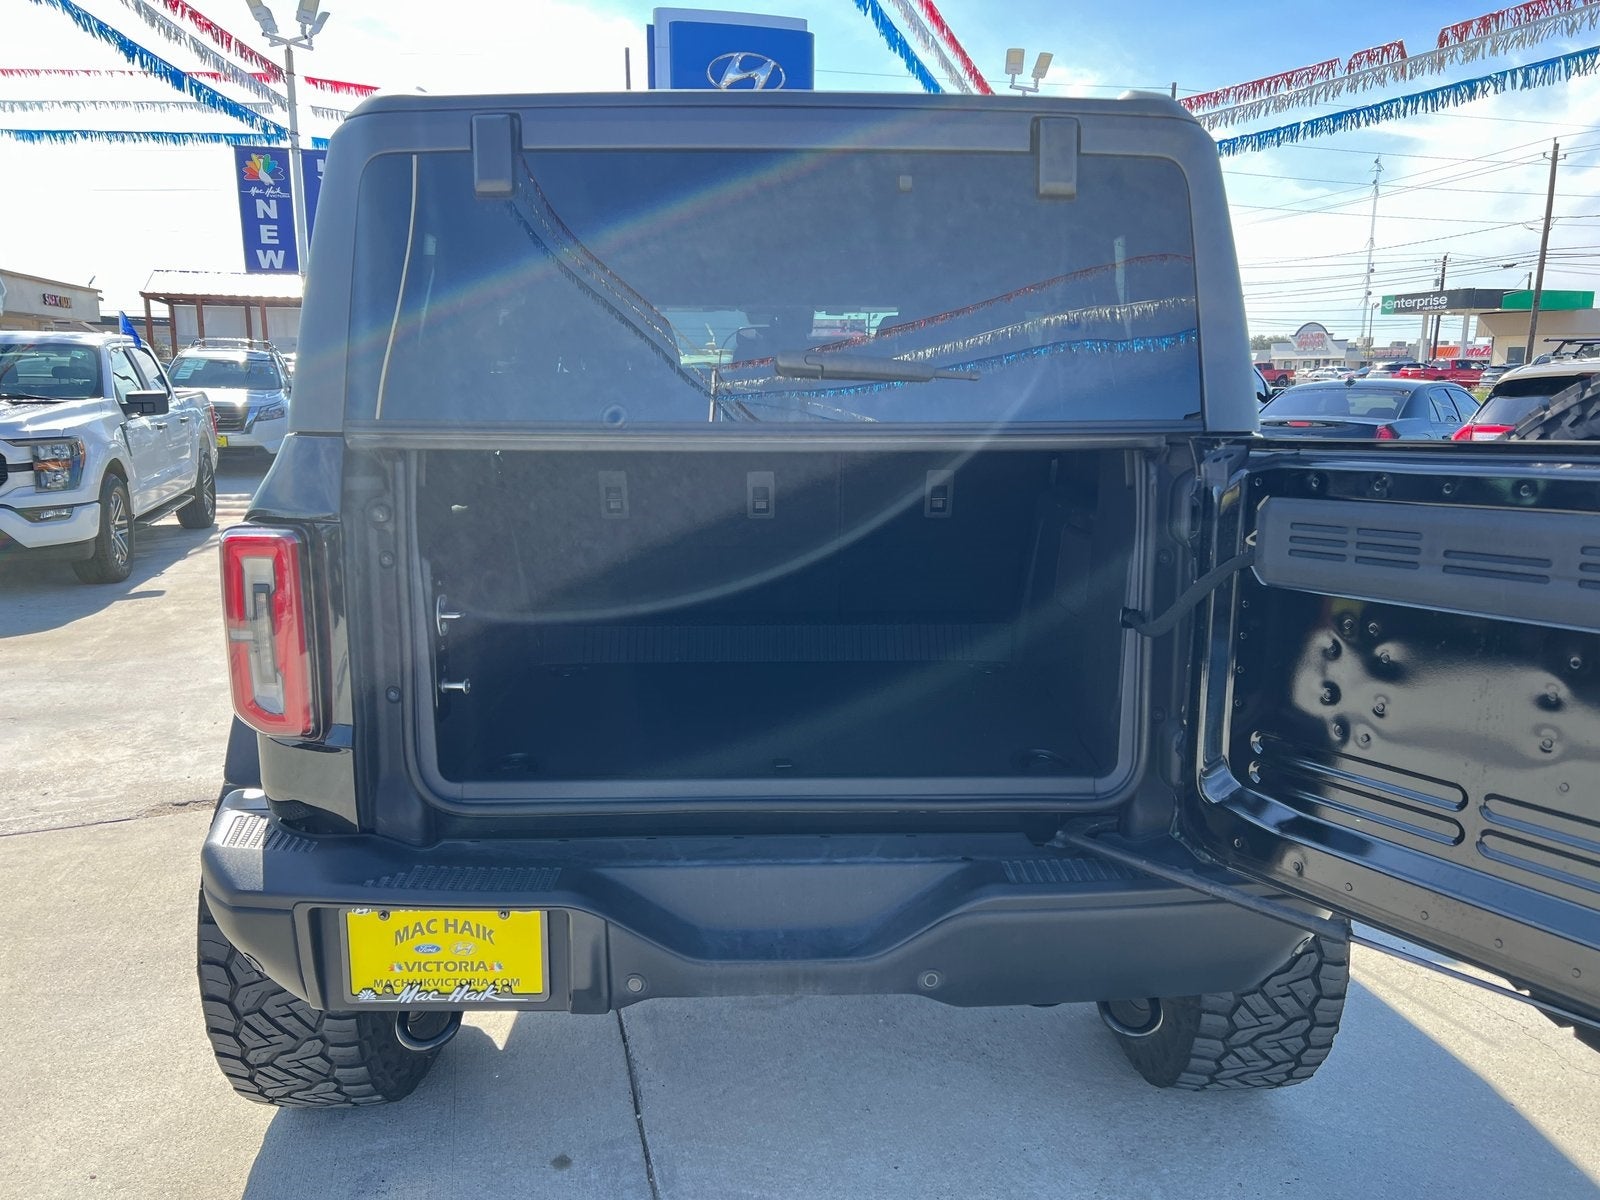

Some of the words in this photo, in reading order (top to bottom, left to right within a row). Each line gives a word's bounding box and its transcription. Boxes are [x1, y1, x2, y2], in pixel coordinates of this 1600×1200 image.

[248, 186, 265, 197] Mac
[265, 186, 283, 197] Haik
[256, 199, 285, 269] NEW
[1384, 295, 1448, 310] enterprise
[394, 918, 438, 946] MAC
[443, 918, 496, 946] HAIK
[417, 944, 438, 953] Ford
[404, 960, 489, 973] VICTORIA
[373, 977, 520, 988] MACHAIKVICTORIACOM
[396, 984, 446, 1004] Mac
[447, 984, 505, 1003] Haik
